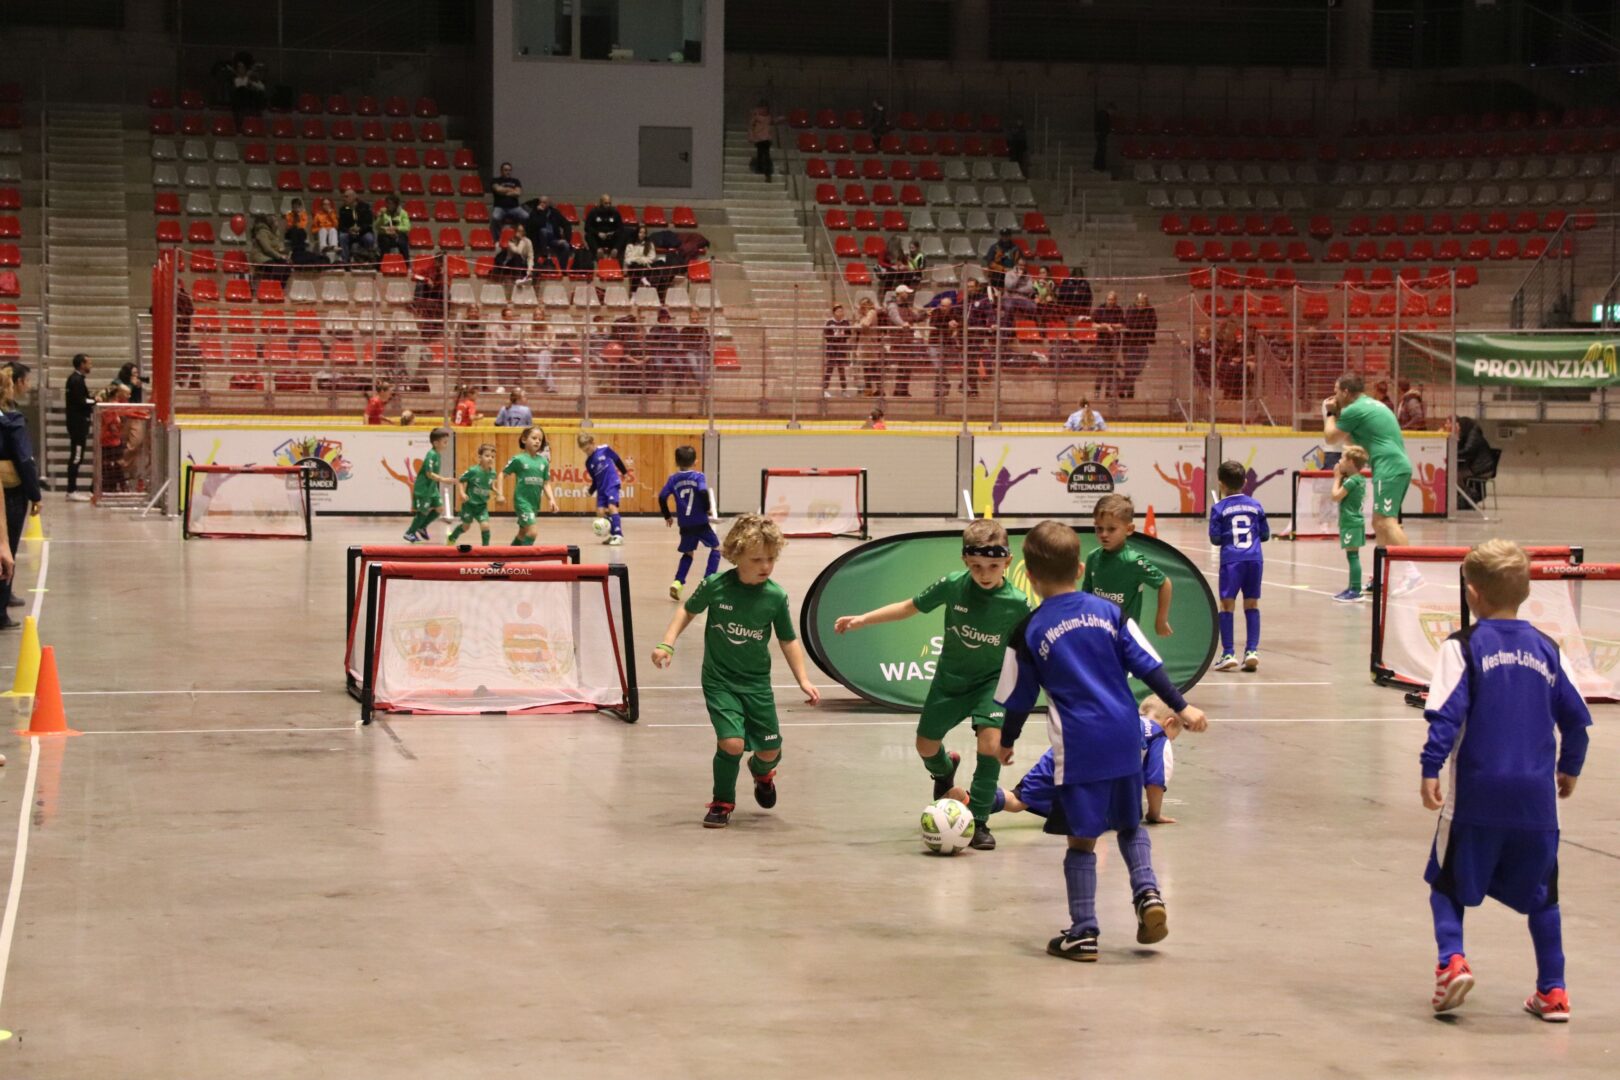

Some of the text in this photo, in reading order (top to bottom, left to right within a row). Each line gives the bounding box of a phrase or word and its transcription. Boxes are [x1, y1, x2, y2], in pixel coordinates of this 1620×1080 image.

[1473, 359, 1610, 379] PROVINZIAL
[1084, 464, 1096, 473] FÜR
[680, 488, 694, 516] 7
[1231, 514, 1253, 549] 6
[459, 567, 533, 576] BAZOOKAGOAL
[1542, 566, 1607, 575] BAZOOKAGOAL
[718, 603, 733, 611] JAKO
[953, 604, 968, 613] JAKO
[726, 622, 764, 641] Süwag
[961, 624, 1001, 647] Süwag
[1038, 639, 1050, 661] SG
[764, 734, 778, 742] JAKO
